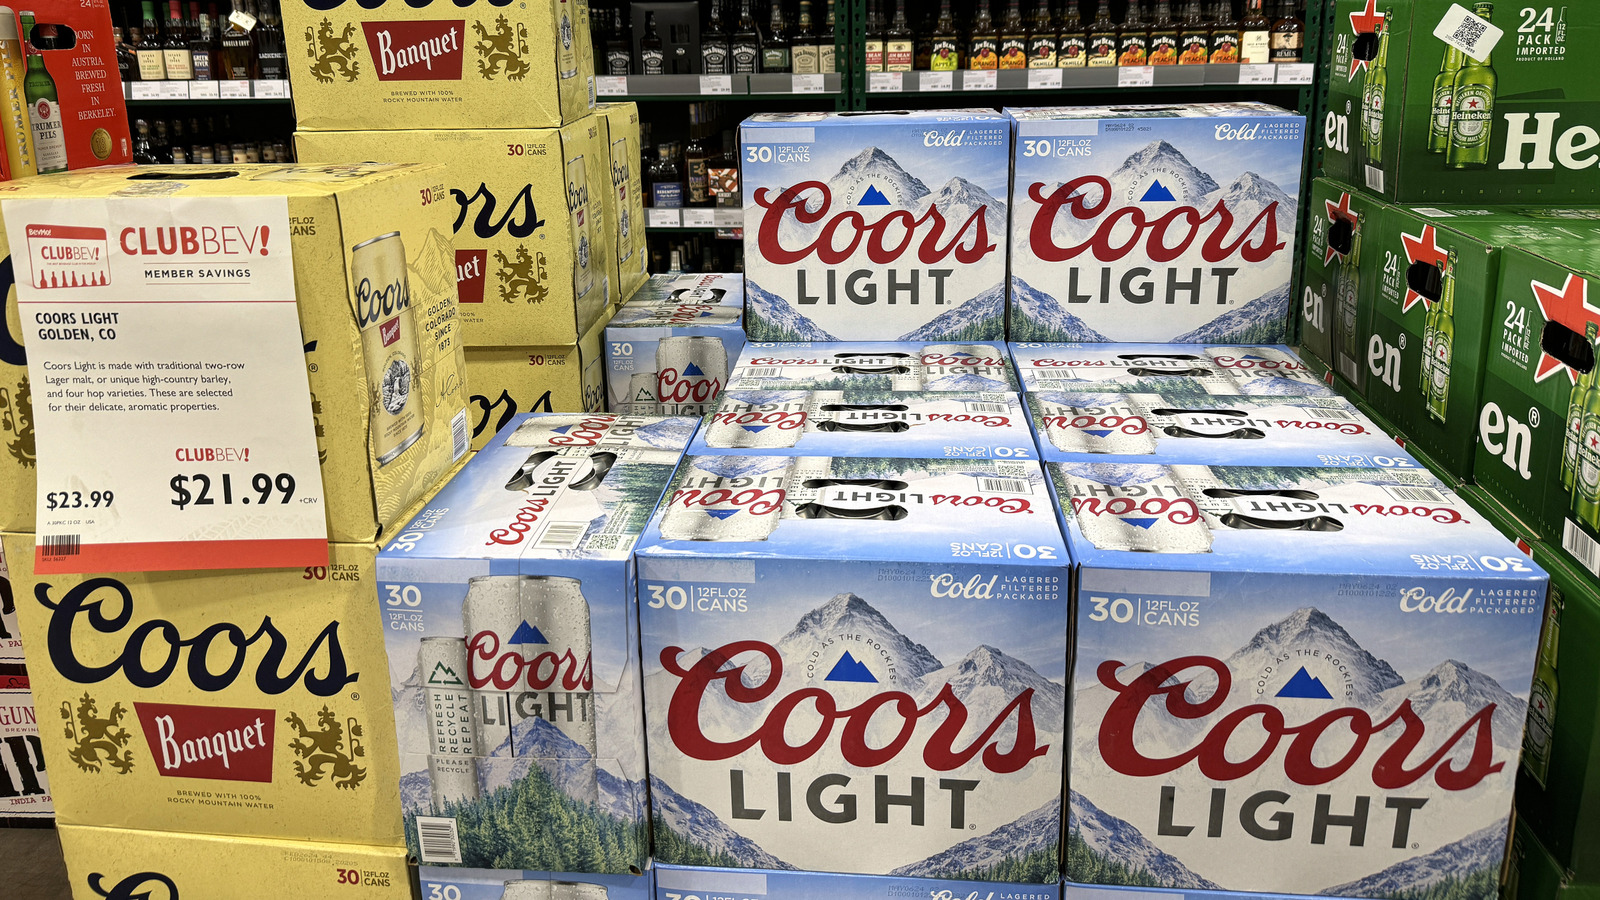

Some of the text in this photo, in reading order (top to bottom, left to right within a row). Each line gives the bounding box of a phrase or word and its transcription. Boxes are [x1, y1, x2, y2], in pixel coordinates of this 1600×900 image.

[1517, 7, 1555, 32] 24
[1336, 33, 1347, 53] 24
[1517, 34, 1551, 45] PACK
[82, 44, 91, 53] IN
[377, 26, 459, 76] Banquet
[1516, 46, 1566, 56] IMPORTED
[72, 57, 104, 67] AUSTRIA.
[75, 70, 107, 80] BREWED
[81, 82, 105, 93] FRESH
[90, 96, 100, 106] IN
[78, 108, 116, 120] BERKELEY.
[1451, 110, 1491, 121] Heineken
[31, 120, 62, 132] TRUMER
[1214, 123, 1258, 141] Cold
[40, 130, 57, 141] PILS
[923, 130, 967, 147] Cold
[746, 146, 772, 163] 30
[1023, 140, 1051, 157] 30
[1057, 147, 1092, 157] CANS
[778, 153, 810, 163] CANS
[753, 180, 998, 265] Coors
[1028, 175, 1287, 262] Coors
[1313, 215, 1323, 234] 24
[119, 225, 270, 257] CLUBBEV!
[41, 246, 99, 261] CLUBBEV!
[1384, 250, 1398, 277] 24
[144, 269, 251, 278] MEMBER SAVINGS
[1383, 272, 1396, 289] PACK
[797, 269, 954, 306] LIGHT
[1068, 266, 1239, 305] LIGHT
[355, 277, 410, 329] Coors
[427, 297, 453, 316] GOLDEN,
[35, 312, 119, 324] COORS LIGHT
[425, 307, 456, 331] COLORADO
[1504, 300, 1526, 334] 24
[38, 328, 117, 342] GOLDEN, CO
[434, 323, 451, 341] SINCE
[1503, 328, 1522, 348] PACK
[438, 337, 451, 352] 1873
[1501, 341, 1529, 364] IMPORTED
[43, 361, 245, 372] Coors Light is made with traditional two-row
[45, 375, 69, 386] Lager
[72, 375, 94, 385] malt,
[109, 376, 140, 386] unique
[142, 375, 198, 386] high-country
[201, 374, 231, 386] barley,
[47, 389, 63, 398] and
[65, 389, 84, 398] four
[87, 388, 104, 400] hop
[107, 388, 147, 398] varieties.
[149, 388, 176, 397] These
[196, 388, 233, 397] selected
[48, 402, 219, 413] for their delicate, aromatic properties.
[175, 447, 249, 462] CLUBBEV!
[46, 490, 114, 511] $23.99
[169, 473, 296, 511] $21.99
[1250, 500, 1350, 515] LIGHT
[485, 497, 549, 546] Coors
[929, 573, 998, 600] Cold
[1001, 584, 1059, 592] FILTERED
[1004, 576, 1059, 584] LAGERED
[385, 585, 422, 607] 30
[647, 585, 746, 609] 30 12FL.OZ
[996, 592, 1059, 601] PACKAGED
[1399, 587, 1474, 614] Cold
[1475, 597, 1536, 606] FILTERED
[1480, 588, 1537, 598] LAGERED
[697, 598, 748, 613] CANS
[1089, 596, 1199, 623] 30 12FL.OZ
[1469, 606, 1535, 615] PACKAGED
[390, 621, 425, 632] CANS
[1144, 612, 1200, 627] CANS
[33, 577, 360, 697] Coors
[464, 630, 594, 691] Coors
[807, 633, 896, 681] COLD AS THE ROCKIES
[1256, 649, 1354, 701] COLD AS THE ROCKIES
[481, 692, 590, 726] LIGHT
[660, 640, 1050, 774] Coors
[434, 693, 447, 753] REFRESH
[445, 693, 459, 754] RECYCLE
[458, 694, 472, 755] REPEAT
[1097, 655, 1506, 791] Coors
[154, 713, 266, 770] Banquet
[9, 796, 36, 805] INDIA
[167, 796, 274, 810] ROCKY MOUNTAIN WATER
[176, 789, 261, 801] BREWED WITH 100%
[730, 769, 981, 830] LIGHT
[1157, 785, 1430, 850] LIGHT
[336, 868, 360, 885] 30
[364, 878, 391, 887] CANS
